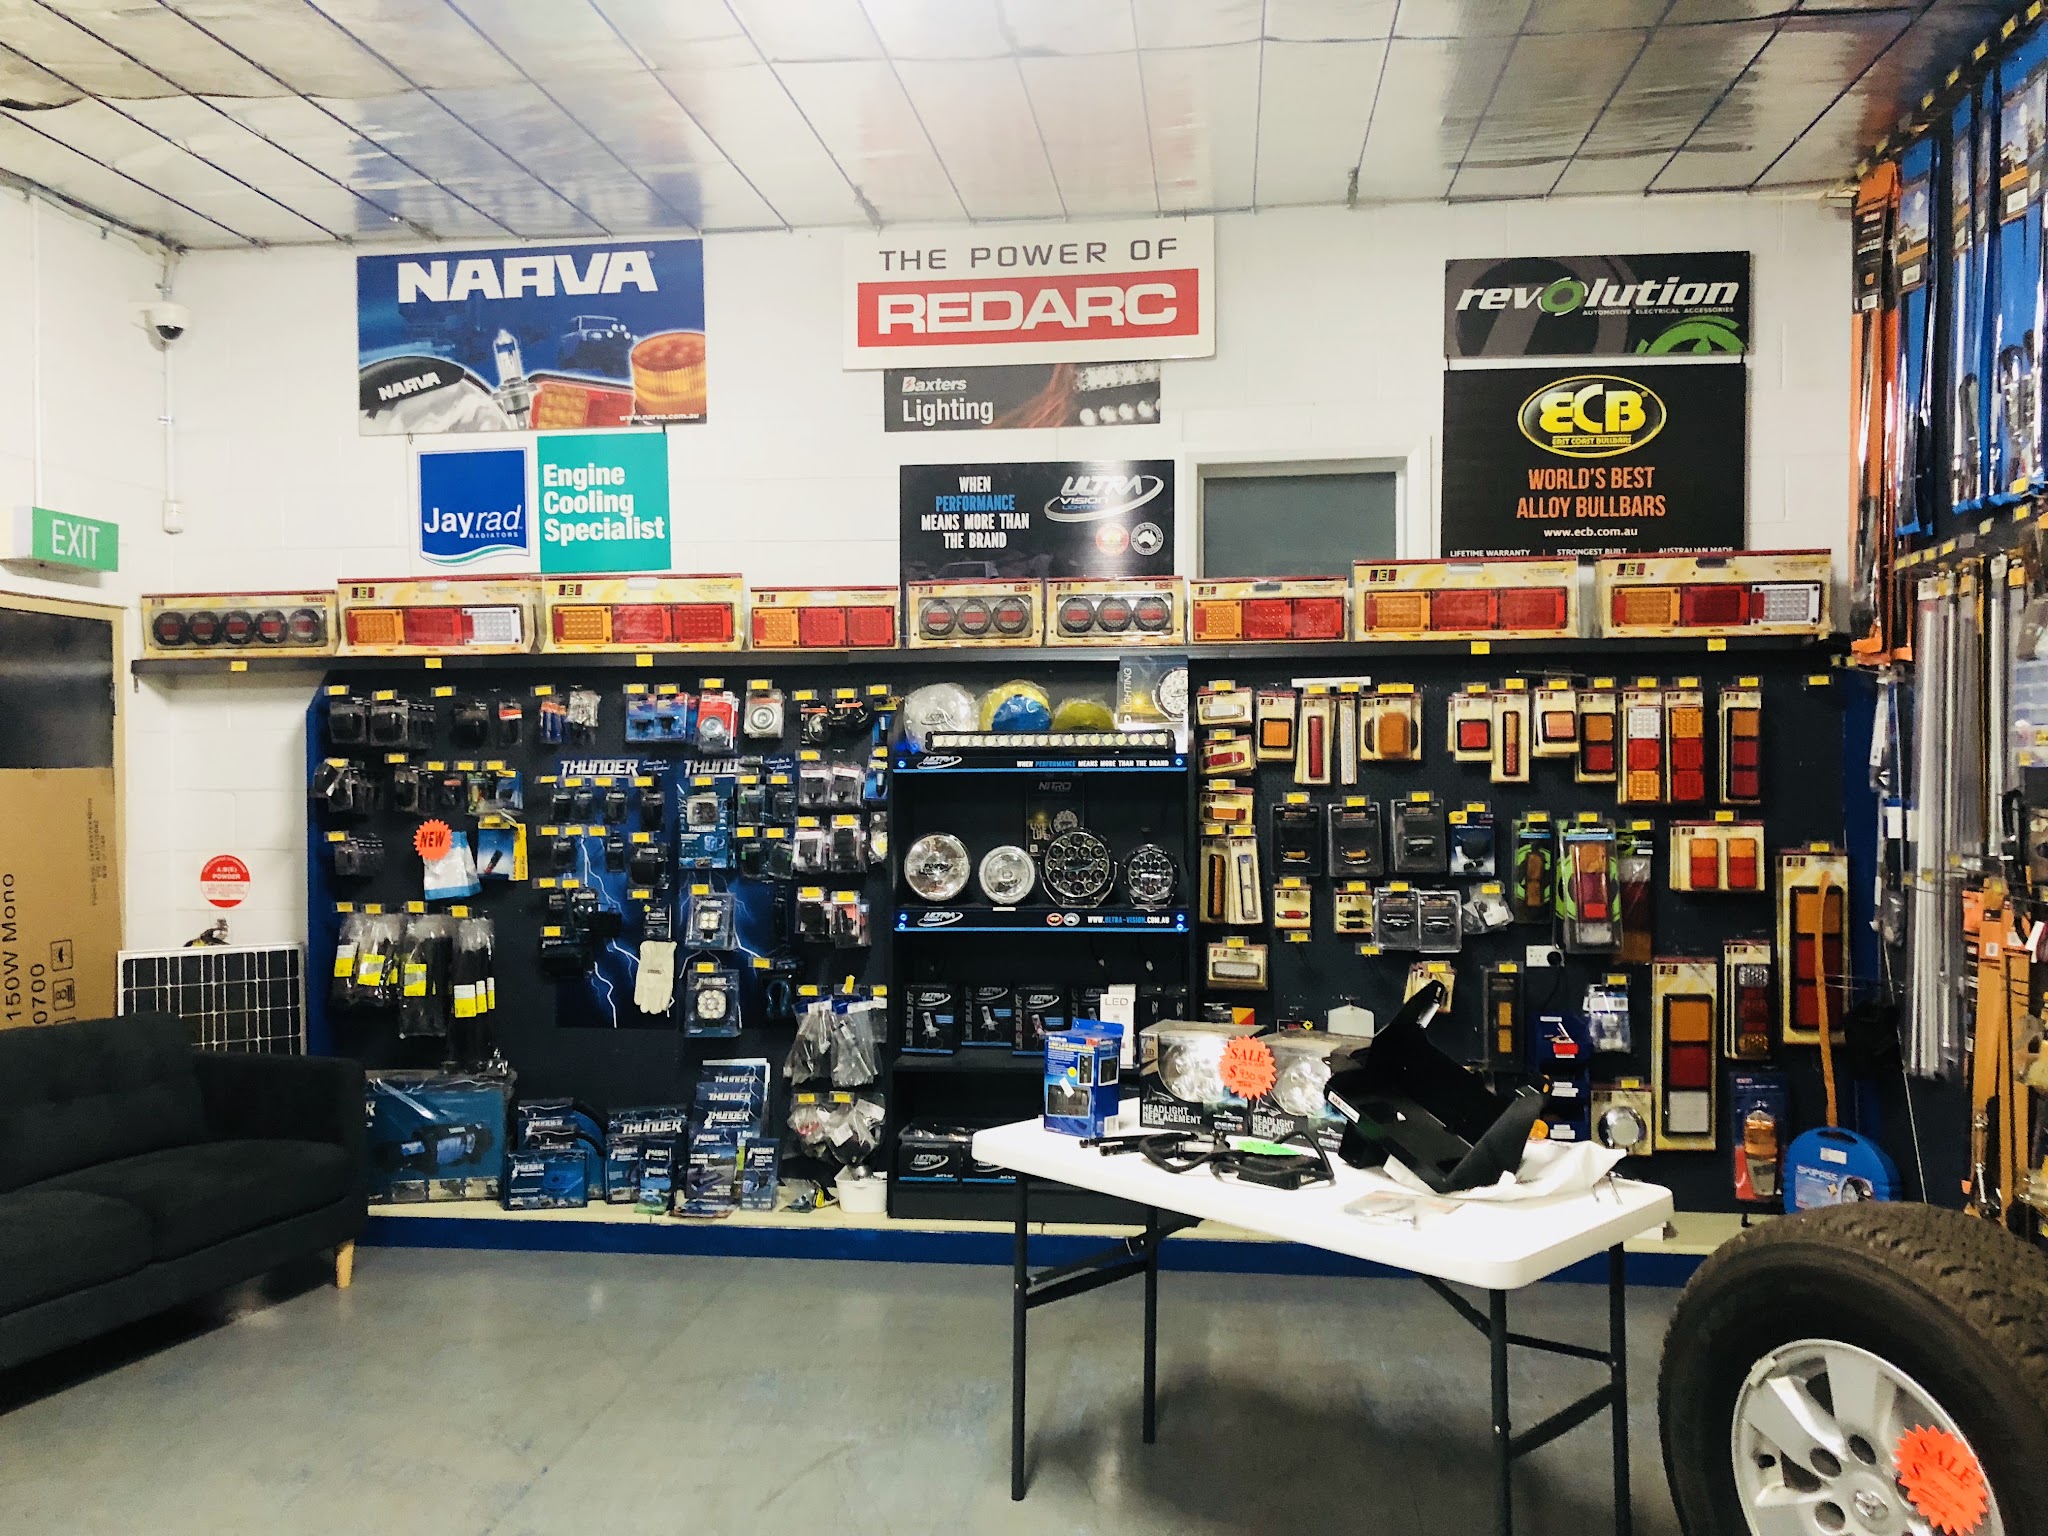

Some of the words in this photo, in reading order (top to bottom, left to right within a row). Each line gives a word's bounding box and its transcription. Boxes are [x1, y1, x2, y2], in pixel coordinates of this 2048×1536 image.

[879, 249, 947, 271] THE
[970, 242, 1108, 269] POWER
[1130, 237, 1178, 261] OF
[398, 250, 659, 303] NARVA
[1455, 275, 1740, 317] revolution
[878, 283, 1178, 334] REDARC
[1582, 308, 1631, 316] AUTOMOTIVE
[1635, 307, 1680, 315] ELECTRICAL
[1683, 306, 1735, 314] ACCESSORIES
[377, 371, 442, 401] NARVA
[902, 376, 968, 392] Baxters
[618, 412, 701, 422] www.narva.com.au
[902, 397, 995, 427] Lighting
[1539, 384, 1647, 434] ECB
[1552, 436, 1570, 445] EAST
[1571, 436, 1595, 445] COAST
[1596, 436, 1632, 445] BULLBARS
[543, 463, 626, 491] Engine
[958, 476, 991, 493] WHEN
[1060, 474, 1142, 497] ULTRA
[1528, 467, 1607, 490] WORLD'S
[1611, 466, 1656, 489] BEST
[543, 490, 635, 517] Cooling
[935, 495, 1016, 512] PERFORMANCE
[1516, 496, 1570, 520] ALLOY
[1576, 494, 1666, 518] BULLBARS
[424, 504, 523, 539] Jayrad
[921, 514, 960, 531] MEANS
[964, 513, 995, 530] MORE
[999, 512, 1030, 529] THAN
[51, 518, 100, 561] EXIT
[469, 531, 519, 540] RADIATORS
[544, 516, 666, 546] Specialist
[943, 532, 964, 549] THE
[968, 531, 1007, 548] BRAND
[1543, 526, 1638, 538] www.ecb.com.au
[1450, 549, 1484, 558] LIFETIME
[1486, 548, 1530, 557] WARRANTY
[1556, 548, 1603, 556] STRONGEST
[1123, 667, 1133, 713] LIGHTING
[560, 759, 640, 778] THUNDER
[1038, 781, 1072, 791] NITRO
[419, 831, 446, 848] NEW
[1, 873, 17, 943] Mono
[1088, 915, 1170, 924] WWW.ULTRA-VISION.COM.AU
[3, 951, 22, 1021] 150W
[30, 963, 48, 1025] 0700
[1104, 997, 1129, 1006] LED
[1229, 1047, 1266, 1062] SALE
[708, 1092, 752, 1101] THUNDER
[707, 1111, 750, 1123] THUNDER
[1142, 1103, 1189, 1116] HEADLIGHT
[1142, 1112, 1202, 1125] REPLACEMENT
[621, 1120, 683, 1134] THUNDER
[1252, 1114, 1295, 1129] HEADLIGHT
